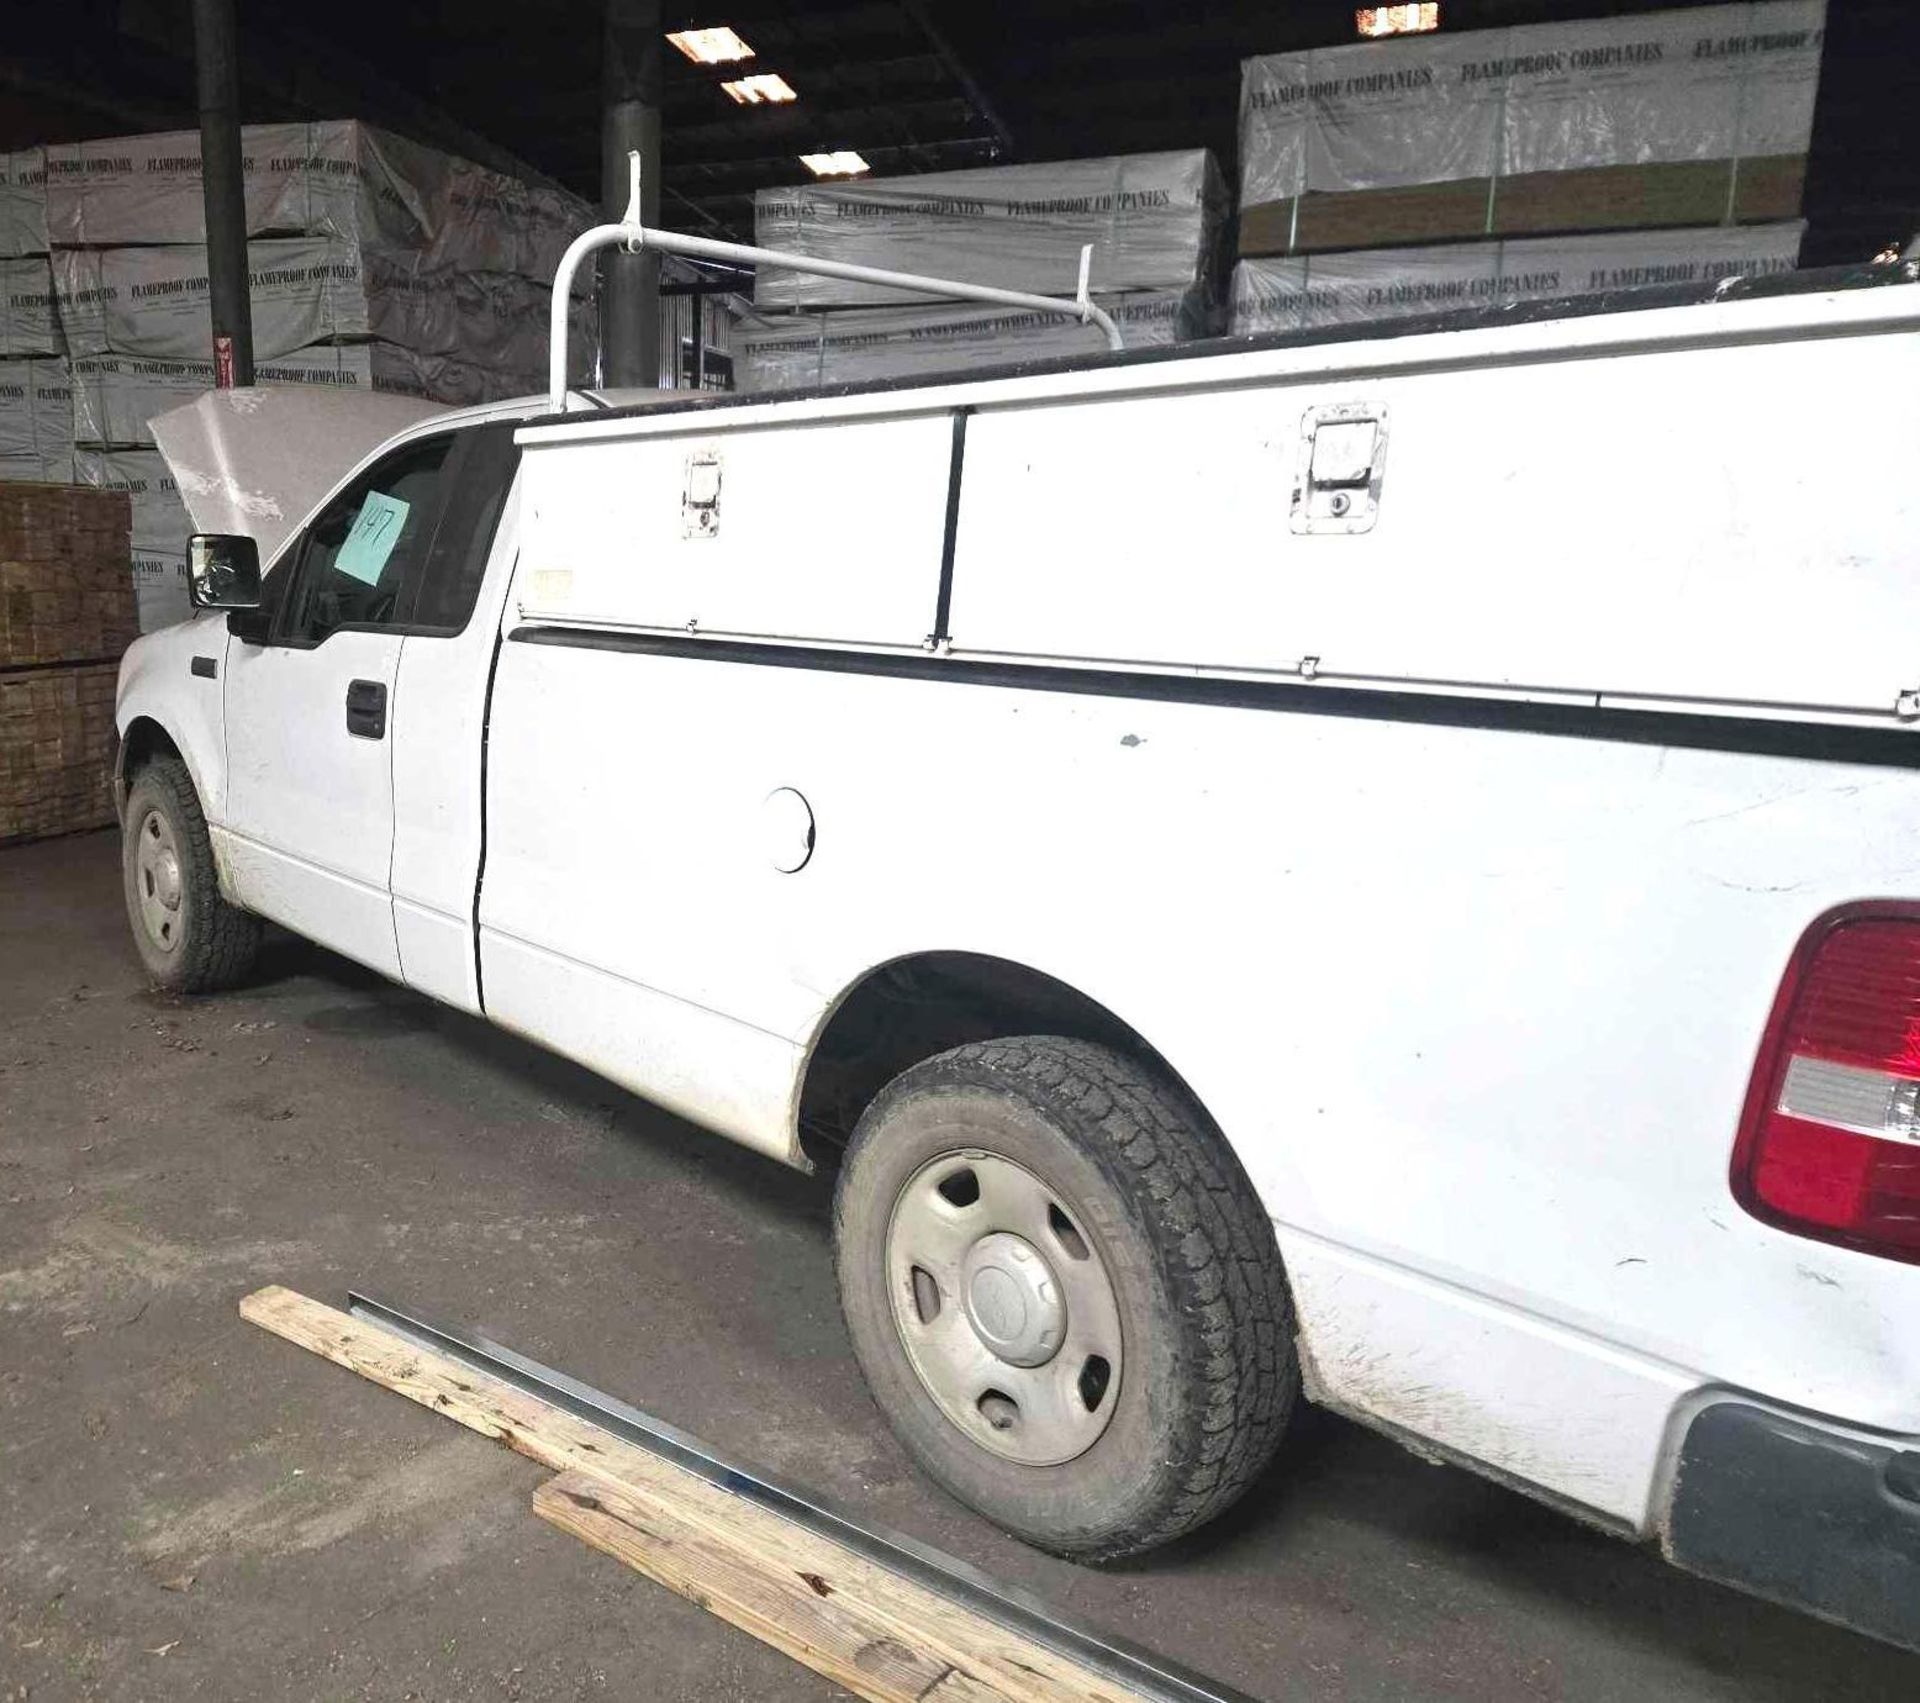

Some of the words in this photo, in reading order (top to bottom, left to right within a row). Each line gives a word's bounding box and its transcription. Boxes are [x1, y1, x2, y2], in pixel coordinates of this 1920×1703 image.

[1346, 65, 1433, 93] COMPANIES
[1460, 51, 1564, 82] FLAMEPROOF
[1569, 42, 1664, 69] COMPANIES
[1469, 271, 1560, 298] COMPANIES
[1590, 263, 1696, 289] FLAMEPROOF
[75, 360, 119, 375] COMPNIES
